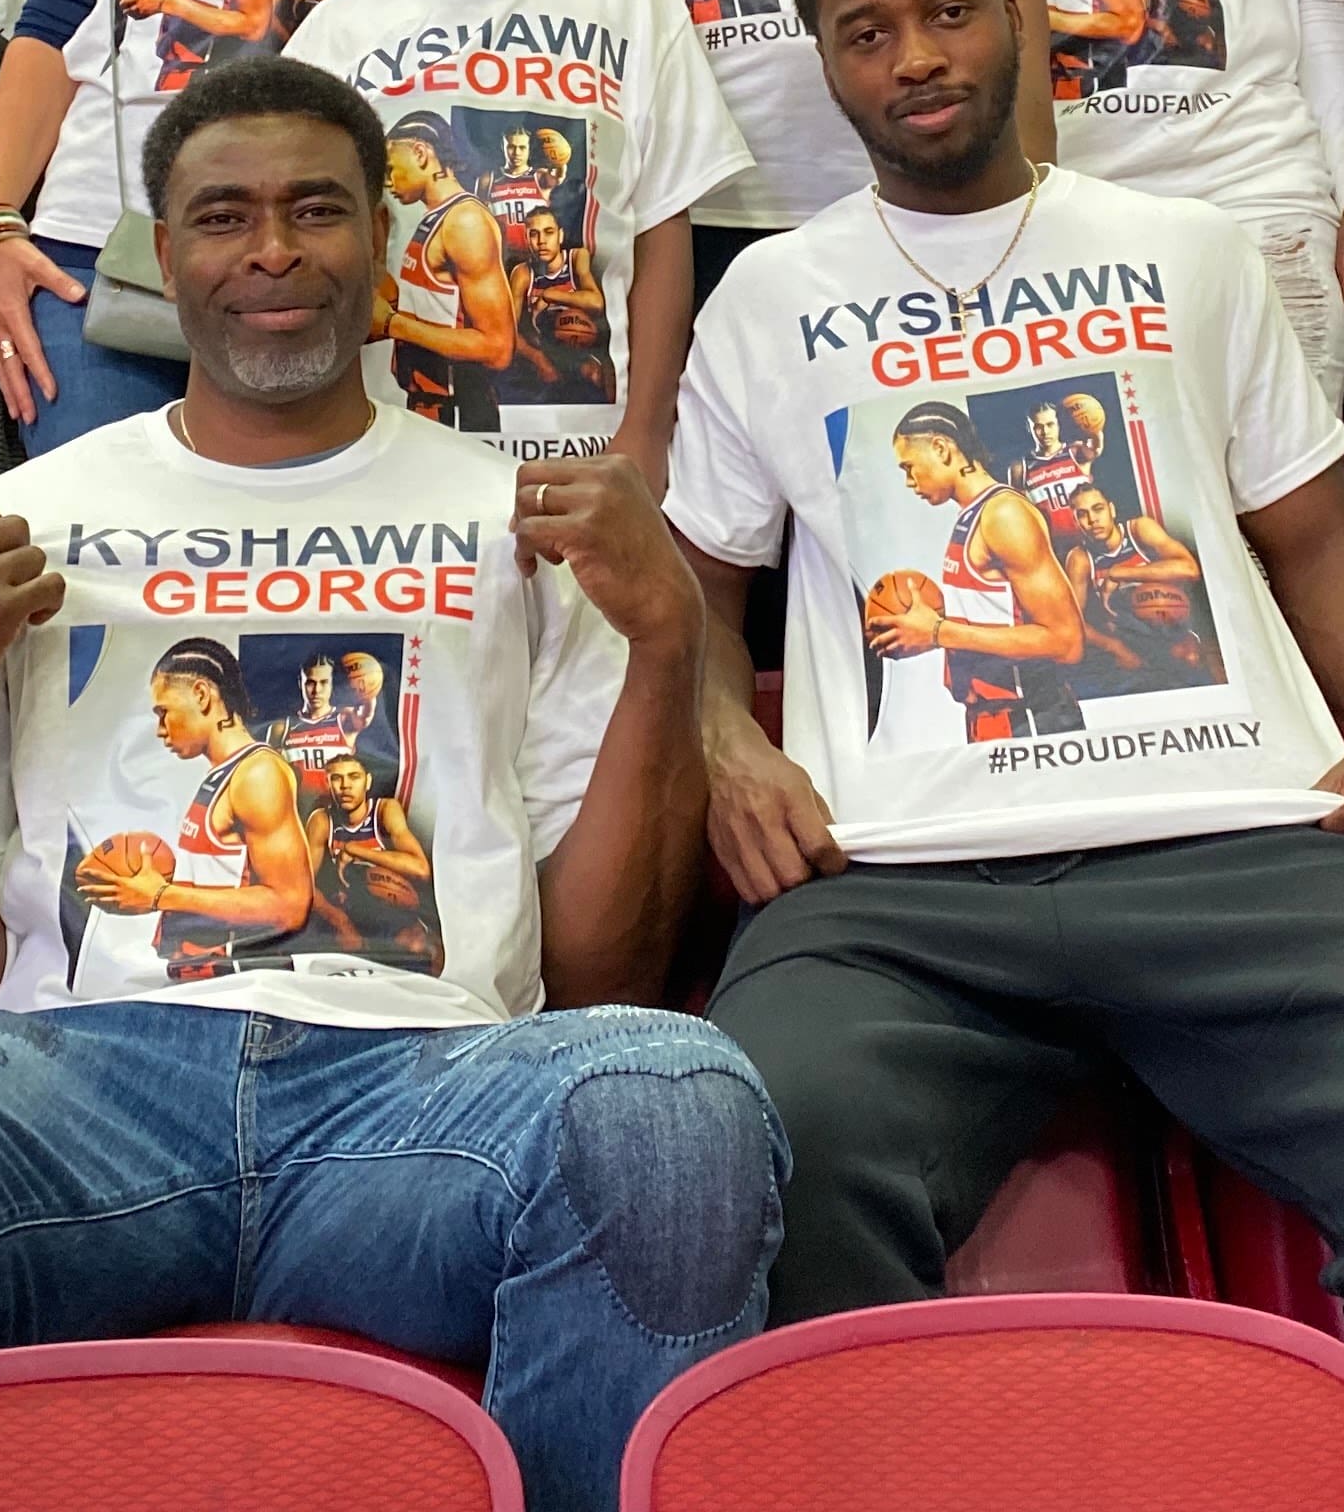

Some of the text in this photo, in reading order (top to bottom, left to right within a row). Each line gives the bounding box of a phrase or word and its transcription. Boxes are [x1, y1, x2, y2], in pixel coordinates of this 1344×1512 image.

[505, 200, 525, 225] 18
[799, 262, 1167, 363] KYSHAWN
[870, 304, 1174, 388] GEORGE
[1044, 482, 1069, 510] 18
[65, 519, 479, 569] KYSHAWN
[142, 565, 476, 621] GEORGE
[302, 748, 325, 770] 18
[989, 720, 1262, 774] #PROUDFAMILY
